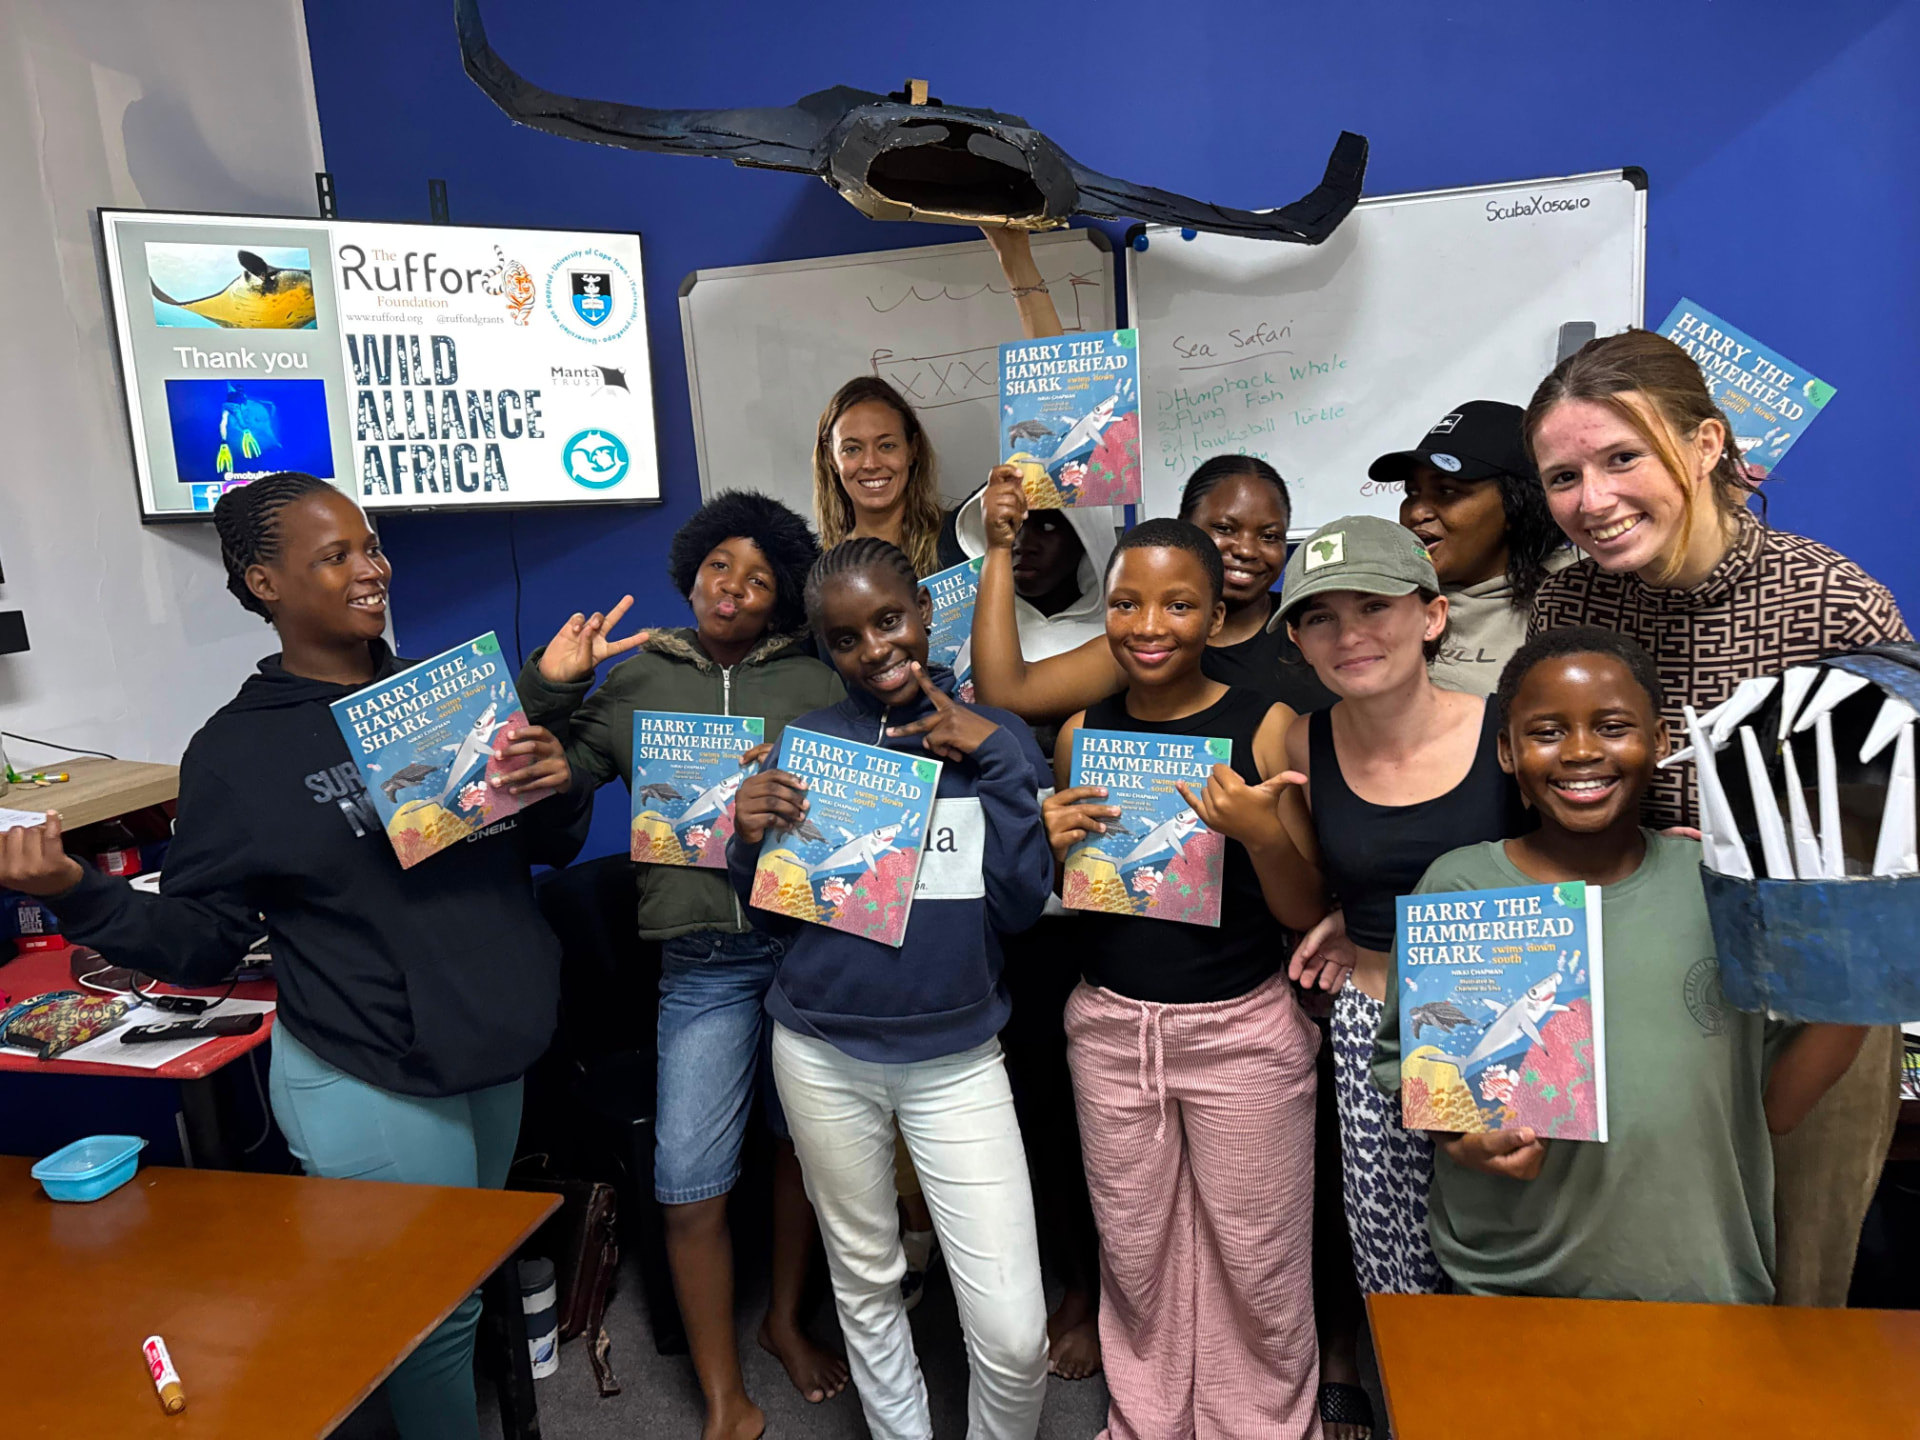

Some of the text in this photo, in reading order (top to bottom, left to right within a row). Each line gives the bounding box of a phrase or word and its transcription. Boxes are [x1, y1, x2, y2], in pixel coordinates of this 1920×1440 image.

[372, 249, 397, 261] The
[552, 251, 582, 271] University
[594, 249, 611, 261] Cape
[613, 258, 628, 274] Town
[377, 295, 449, 308] Foundation
[346, 312, 505, 326] www.rufford.org @ruffordgrants
[1173, 320, 1295, 358] Sea Safari
[1676, 312, 1752, 363] HARRY
[1751, 356, 1795, 391] THE
[173, 346, 309, 373] Thank you
[345, 333, 459, 386] WILD
[1006, 344, 1063, 364] HARRY
[1069, 340, 1105, 356] THE
[551, 366, 600, 378] Manta
[1006, 355, 1128, 380] HAMMERHEAD
[1290, 353, 1348, 381] Whale
[1667, 329, 1804, 421] HAMMERHEAD
[552, 378, 601, 387] TRUST
[1006, 377, 1062, 396] SHARK
[1246, 391, 1284, 408] Fish
[357, 389, 545, 441] ALLIANCE
[1289, 407, 1348, 426] Turtle
[363, 443, 509, 495] AFRICA
[932, 573, 966, 595] THE
[346, 656, 467, 722] HARRY THE
[353, 661, 496, 738] HAMMERHEAD
[361, 713, 433, 754] SHARK
[641, 718, 734, 736] HARRY THE
[640, 733, 754, 751] HAMMERHEAD
[640, 747, 694, 762] SHARK
[1082, 737, 1150, 755] HARRY
[1157, 742, 1194, 759] THE
[791, 737, 859, 766] HARRY
[865, 754, 901, 778] THE
[304, 761, 367, 803] SUR
[787, 754, 921, 800] HAMMERHEAD
[1080, 771, 1145, 790] SHARK
[1406, 896, 1542, 923] HARRY THE
[1406, 917, 1574, 944] HAMMERHEAD
[1407, 942, 1556, 966] SHARK swims down
[1491, 954, 1522, 964] south
